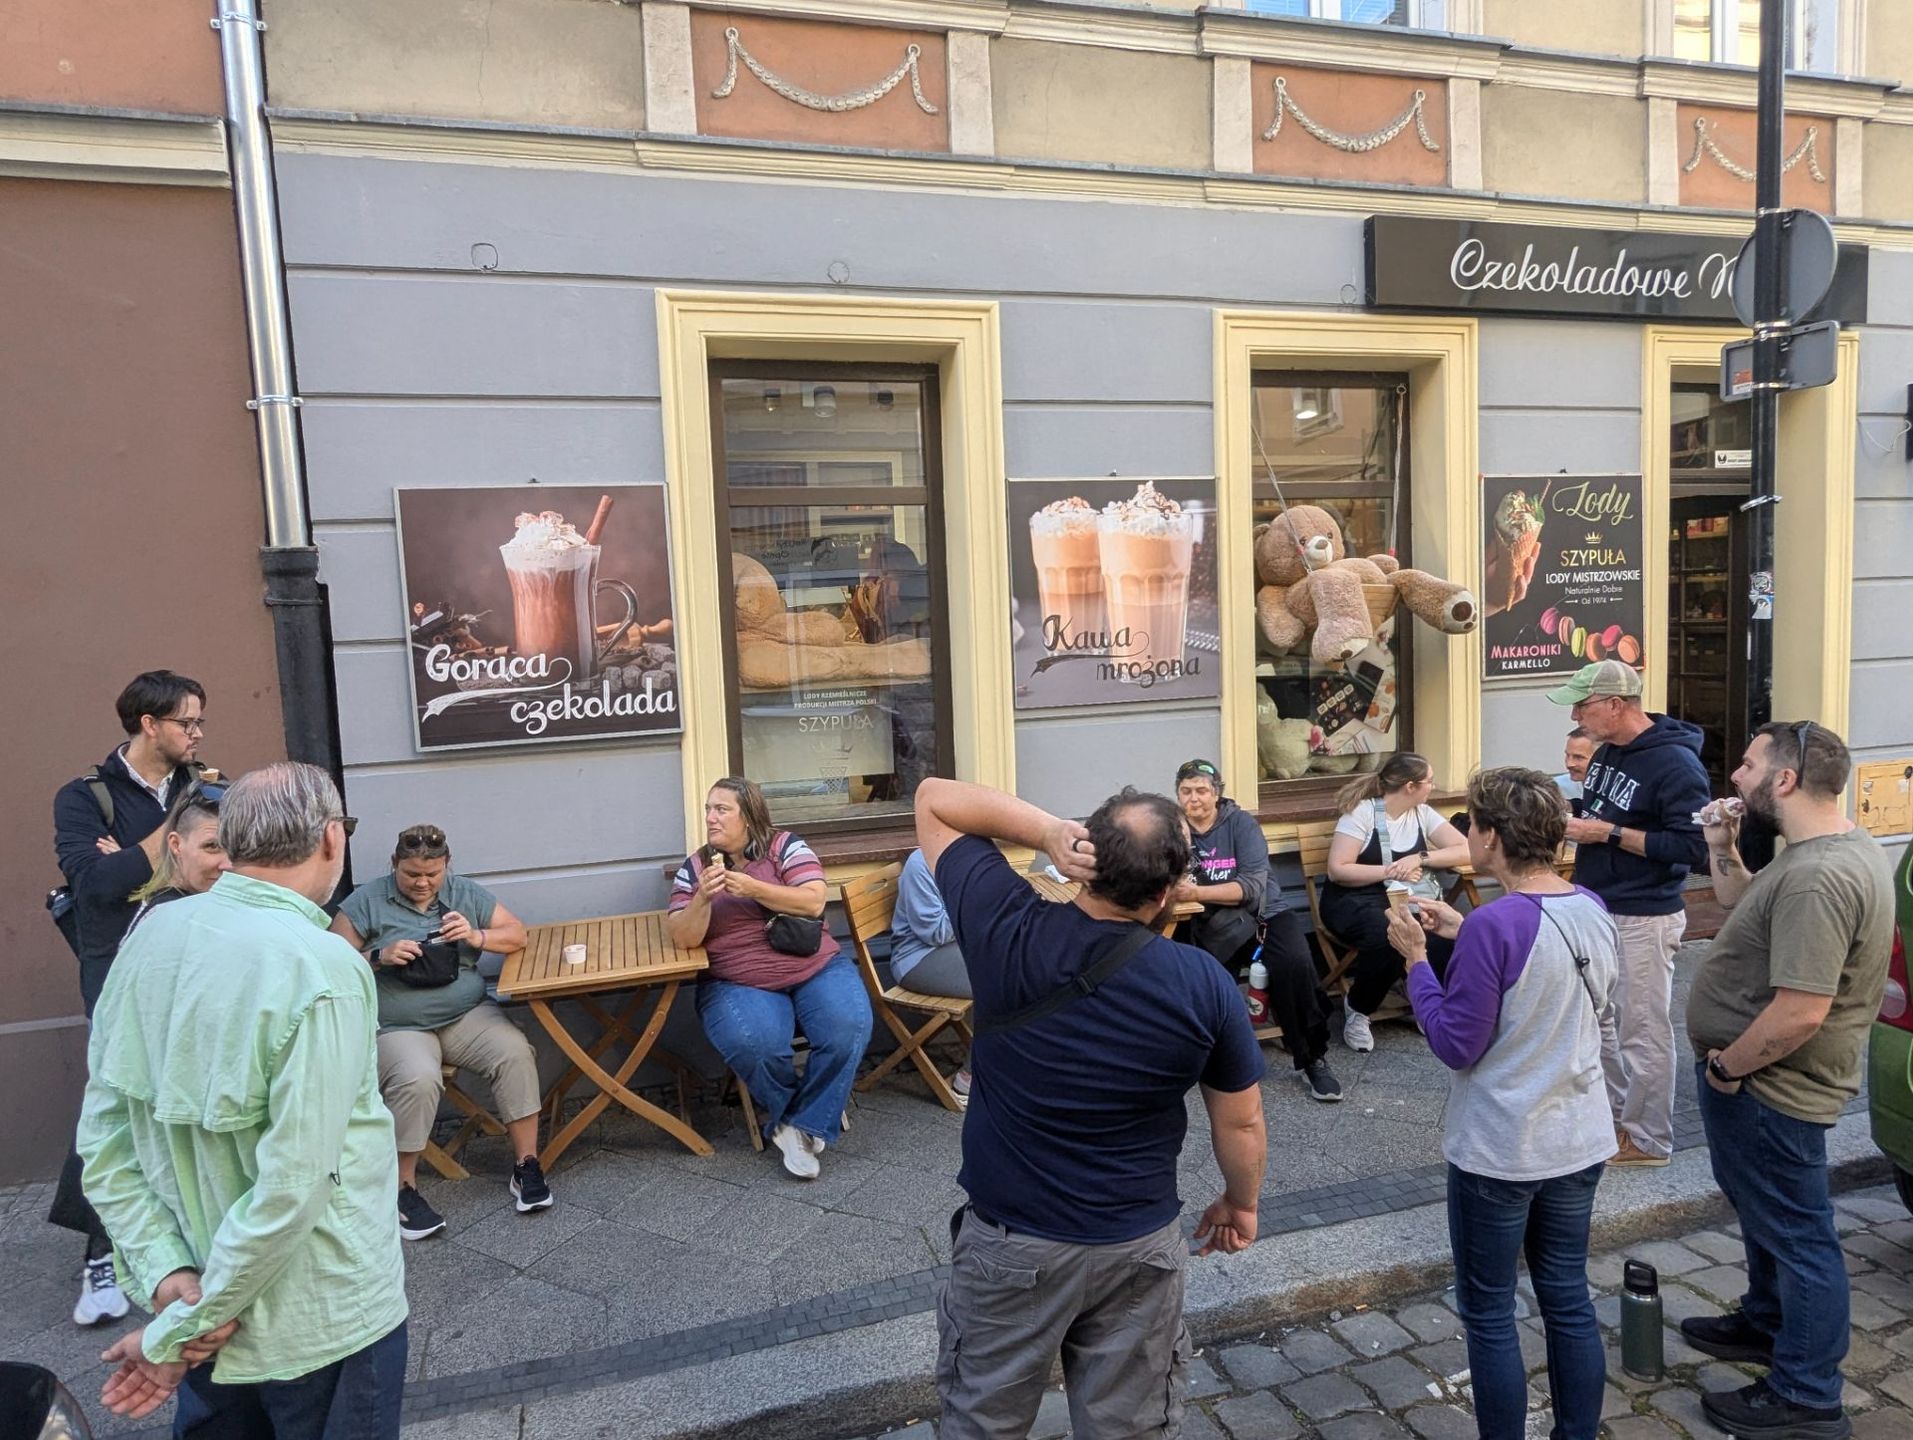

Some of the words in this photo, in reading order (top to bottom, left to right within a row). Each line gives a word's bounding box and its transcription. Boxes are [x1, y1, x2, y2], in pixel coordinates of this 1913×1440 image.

[1450, 238, 1692, 298] Czekoladowe
[1552, 480, 1634, 526] Lody
[1560, 548, 1627, 567] SZYPUŁA
[1545, 572, 1571, 584] LODY
[1572, 569, 1641, 583] MISTRZOWSKIE
[1042, 614, 1134, 652] Kawa
[1491, 643, 1561, 659] MAKARONIKI
[425, 643, 552, 683] Gorąca
[1097, 653, 1202, 689] mrożona
[1501, 657, 1551, 670] KARMELLO
[510, 677, 678, 735] czekolada
